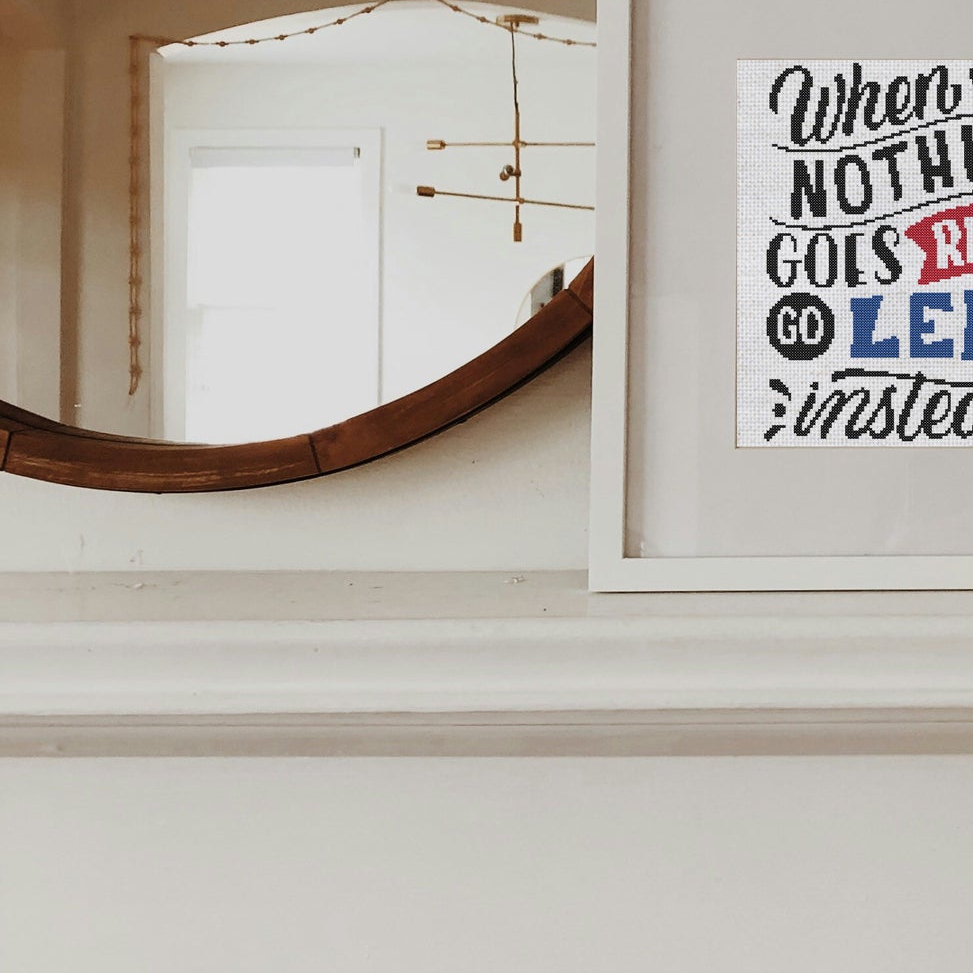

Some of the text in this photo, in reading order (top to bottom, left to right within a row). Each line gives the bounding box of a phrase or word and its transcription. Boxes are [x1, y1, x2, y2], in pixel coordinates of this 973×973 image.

[769, 62, 962, 146] When
[766, 225, 903, 288] GOES
[777, 305, 825, 345] GO
